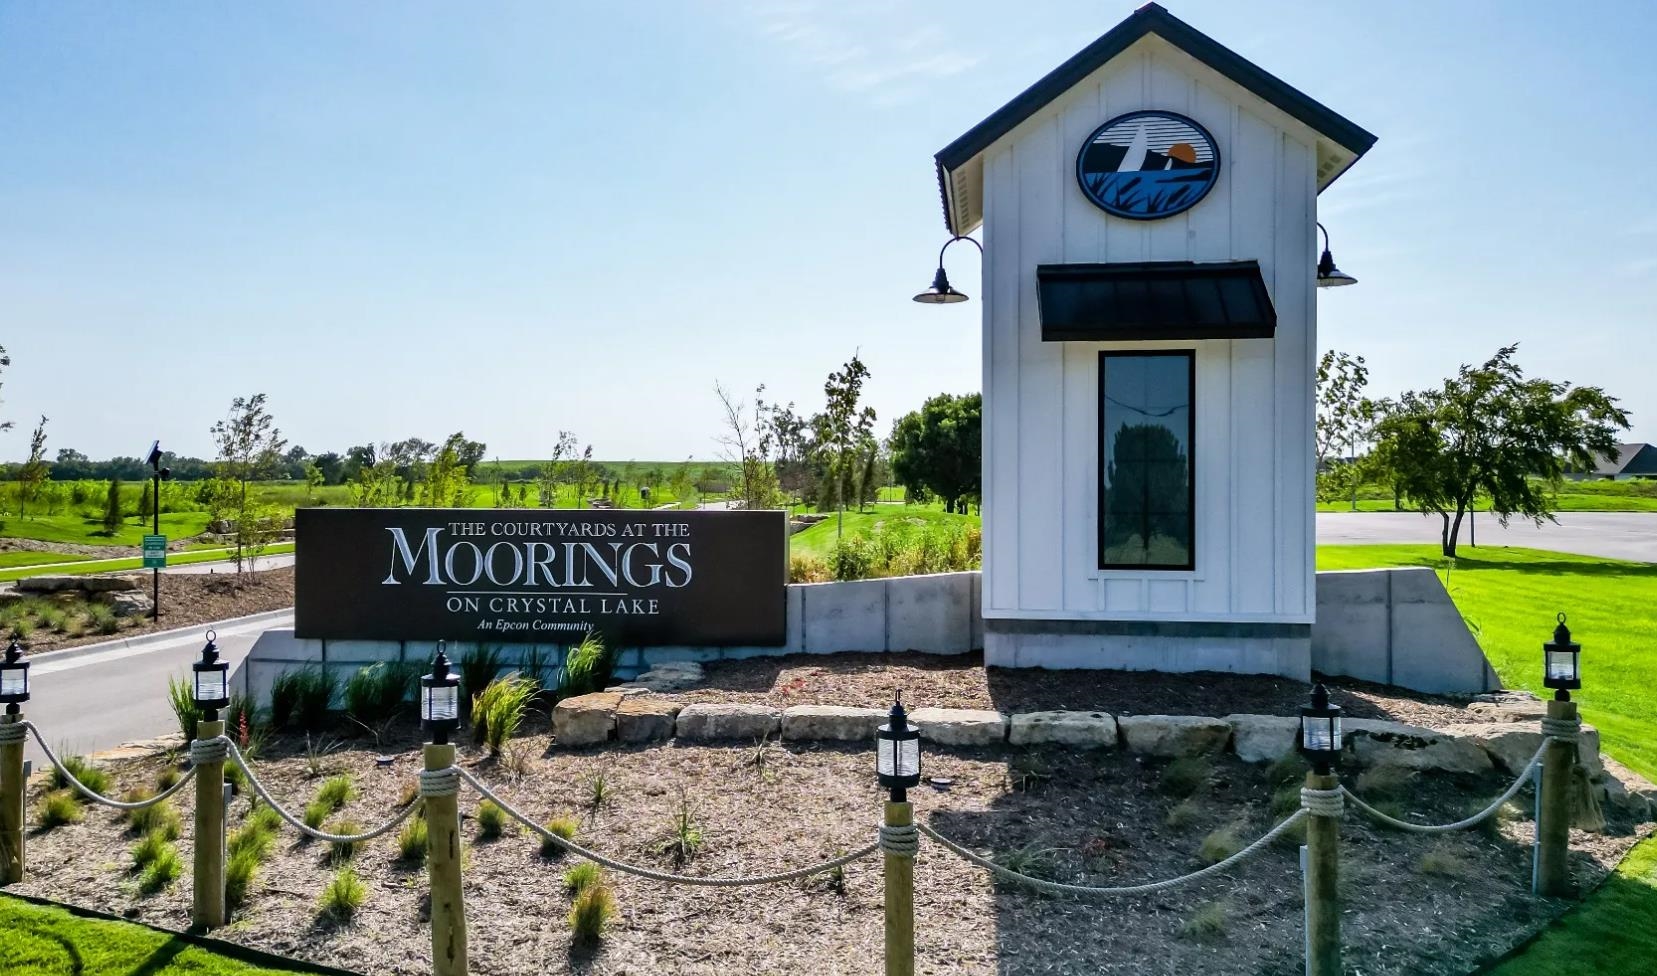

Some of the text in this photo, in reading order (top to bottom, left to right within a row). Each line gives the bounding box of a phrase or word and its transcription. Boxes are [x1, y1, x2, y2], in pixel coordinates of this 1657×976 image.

[448, 522, 690, 537] THE COURTYARDS AT THE
[381, 527, 693, 588] MOORINGS
[446, 597, 660, 615] ON CRYSTAL LAKE
[477, 619, 595, 634] An Epcon Community
